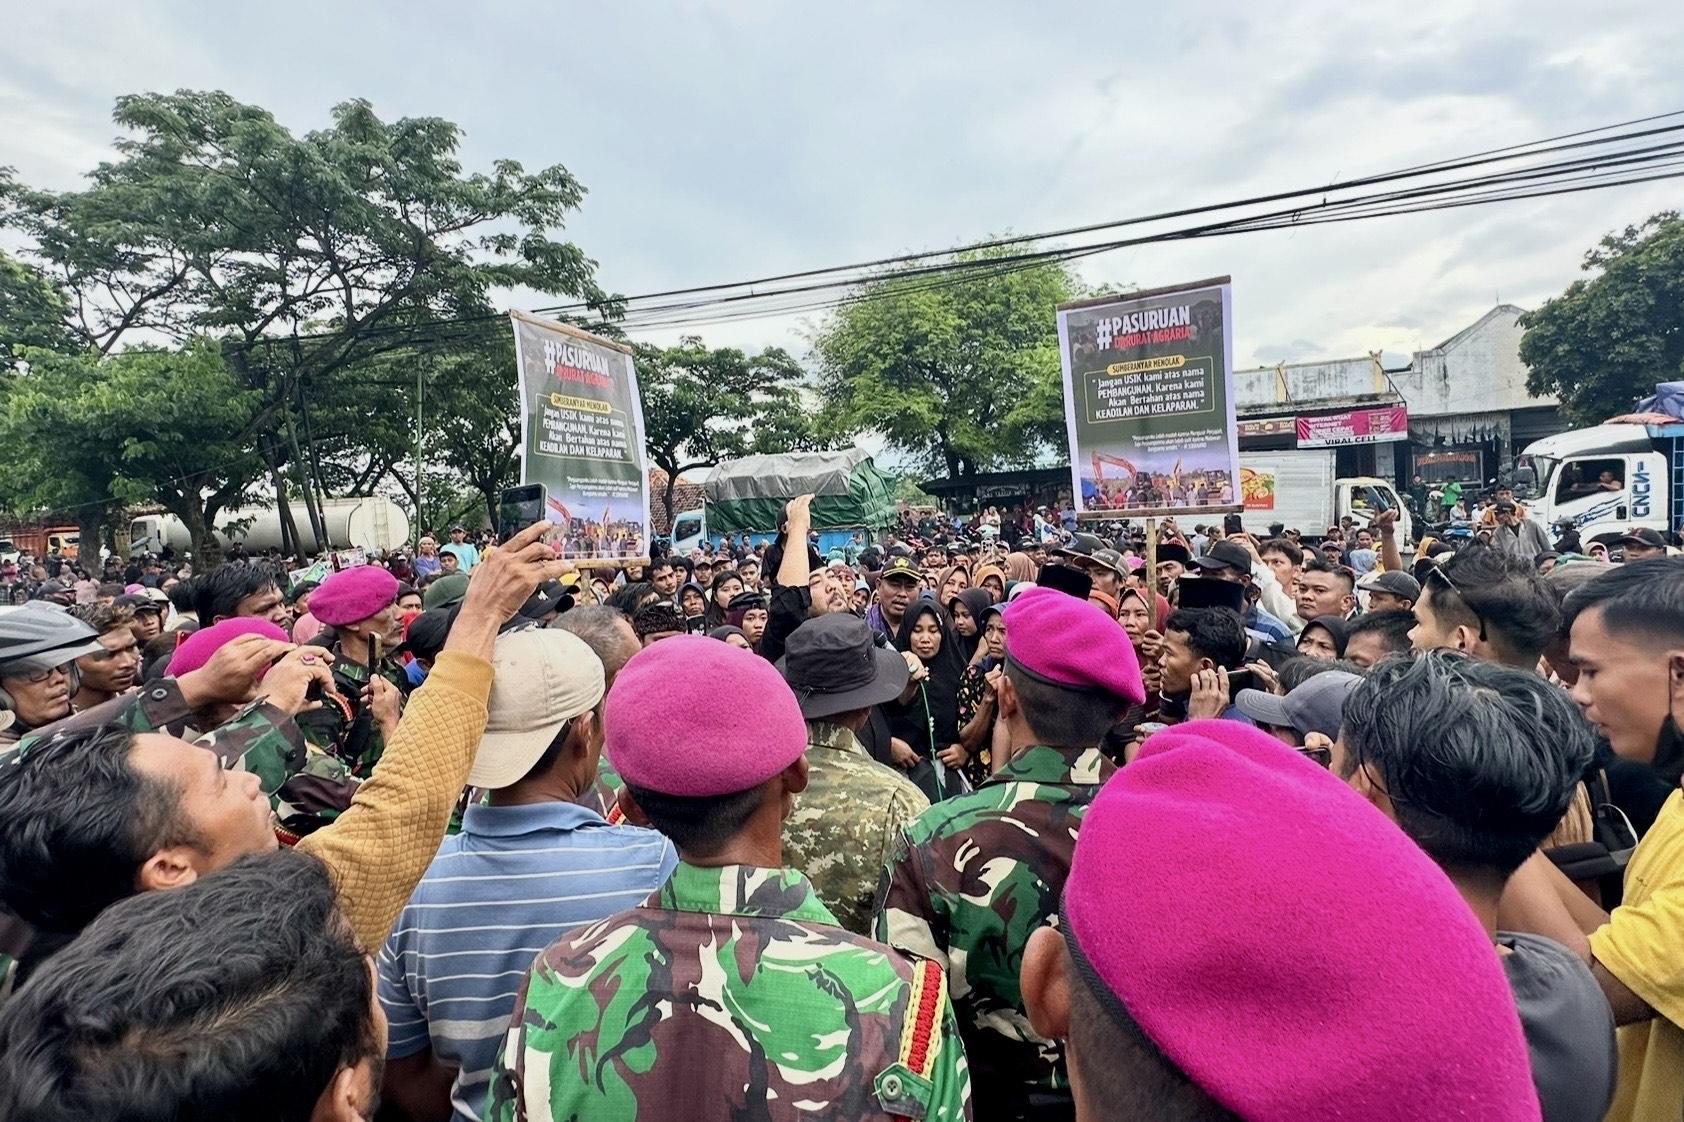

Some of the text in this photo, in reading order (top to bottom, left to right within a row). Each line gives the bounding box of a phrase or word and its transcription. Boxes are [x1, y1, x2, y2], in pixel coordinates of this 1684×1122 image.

[1096, 305, 1190, 350] #PASURUAN
[544, 340, 610, 376] #PASURUAN
[1153, 357, 1180, 368] MENOLAK
[1098, 378, 1122, 390] Jangan
[1124, 373, 1142, 384] USIK
[1144, 371, 1162, 382] kami
[1164, 370, 1180, 380] atas
[1182, 368, 1204, 377] nama
[1156, 382, 1182, 392] Karena
[1184, 378, 1204, 389] kami
[1108, 390, 1204, 408] Akan Bertahan atas nama
[560, 410, 578, 420] USIK
[580, 411, 594, 422] kami
[1096, 406, 1132, 419] KEADILAN
[1134, 404, 1150, 415] DAN
[1151, 400, 1199, 414] KELAPARAN.
[588, 425, 612, 437] Karena
[570, 444, 584, 456] DAN
